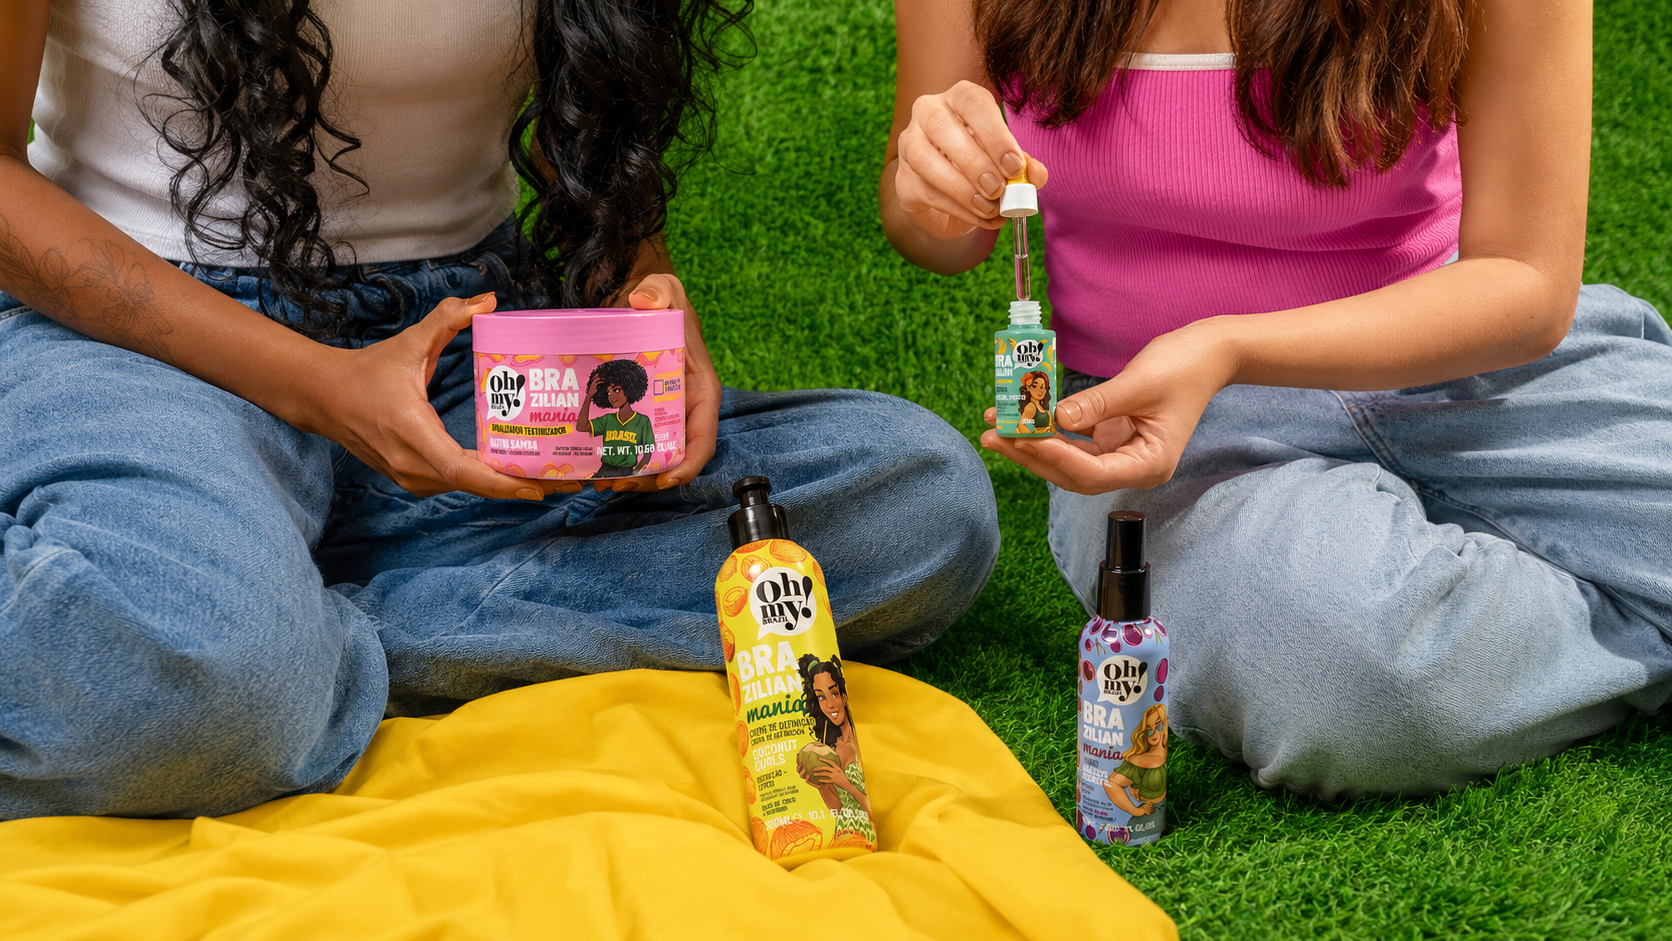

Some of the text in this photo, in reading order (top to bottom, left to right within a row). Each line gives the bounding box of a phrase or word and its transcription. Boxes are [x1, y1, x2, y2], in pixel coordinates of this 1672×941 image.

[529, 368, 580, 391] BRA
[529, 392, 579, 408] ZILIAN
[529, 407, 578, 423] mania
[737, 641, 800, 683] BRA
[742, 673, 804, 704] ZILIAN
[746, 694, 808, 724] mania
[1083, 700, 1124, 730] BRA
[1083, 724, 1123, 746] ZILIAN
[752, 739, 798, 761] COCONUT
[1083, 743, 1123, 760] mania
